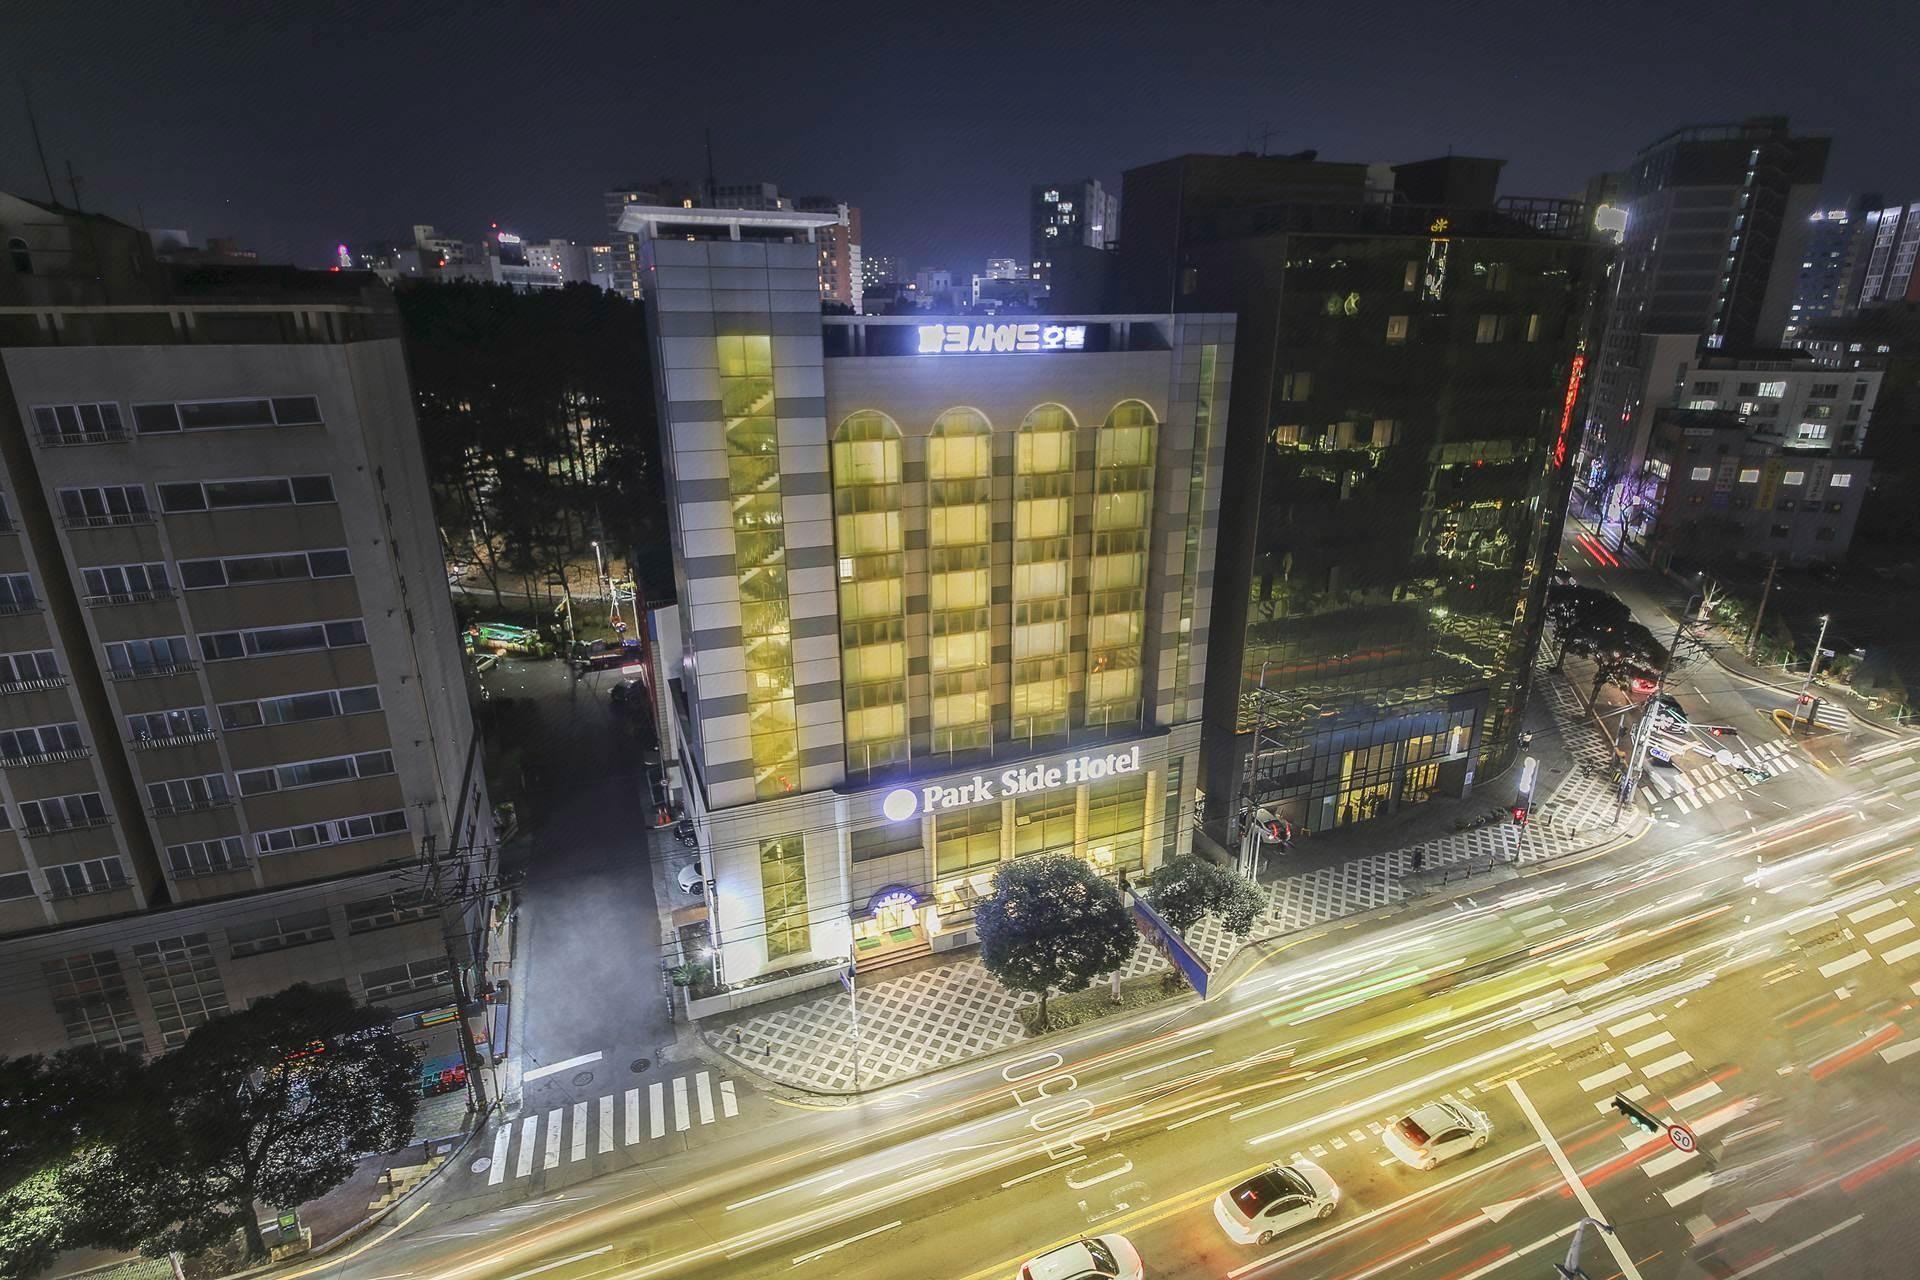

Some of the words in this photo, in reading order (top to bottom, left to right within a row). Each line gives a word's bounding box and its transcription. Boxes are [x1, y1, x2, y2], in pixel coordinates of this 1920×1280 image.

[922, 776, 994, 813] Park
[1001, 764, 1061, 797] Side
[1065, 746, 1140, 784] Hotel
[1673, 1130, 1690, 1147] 50
